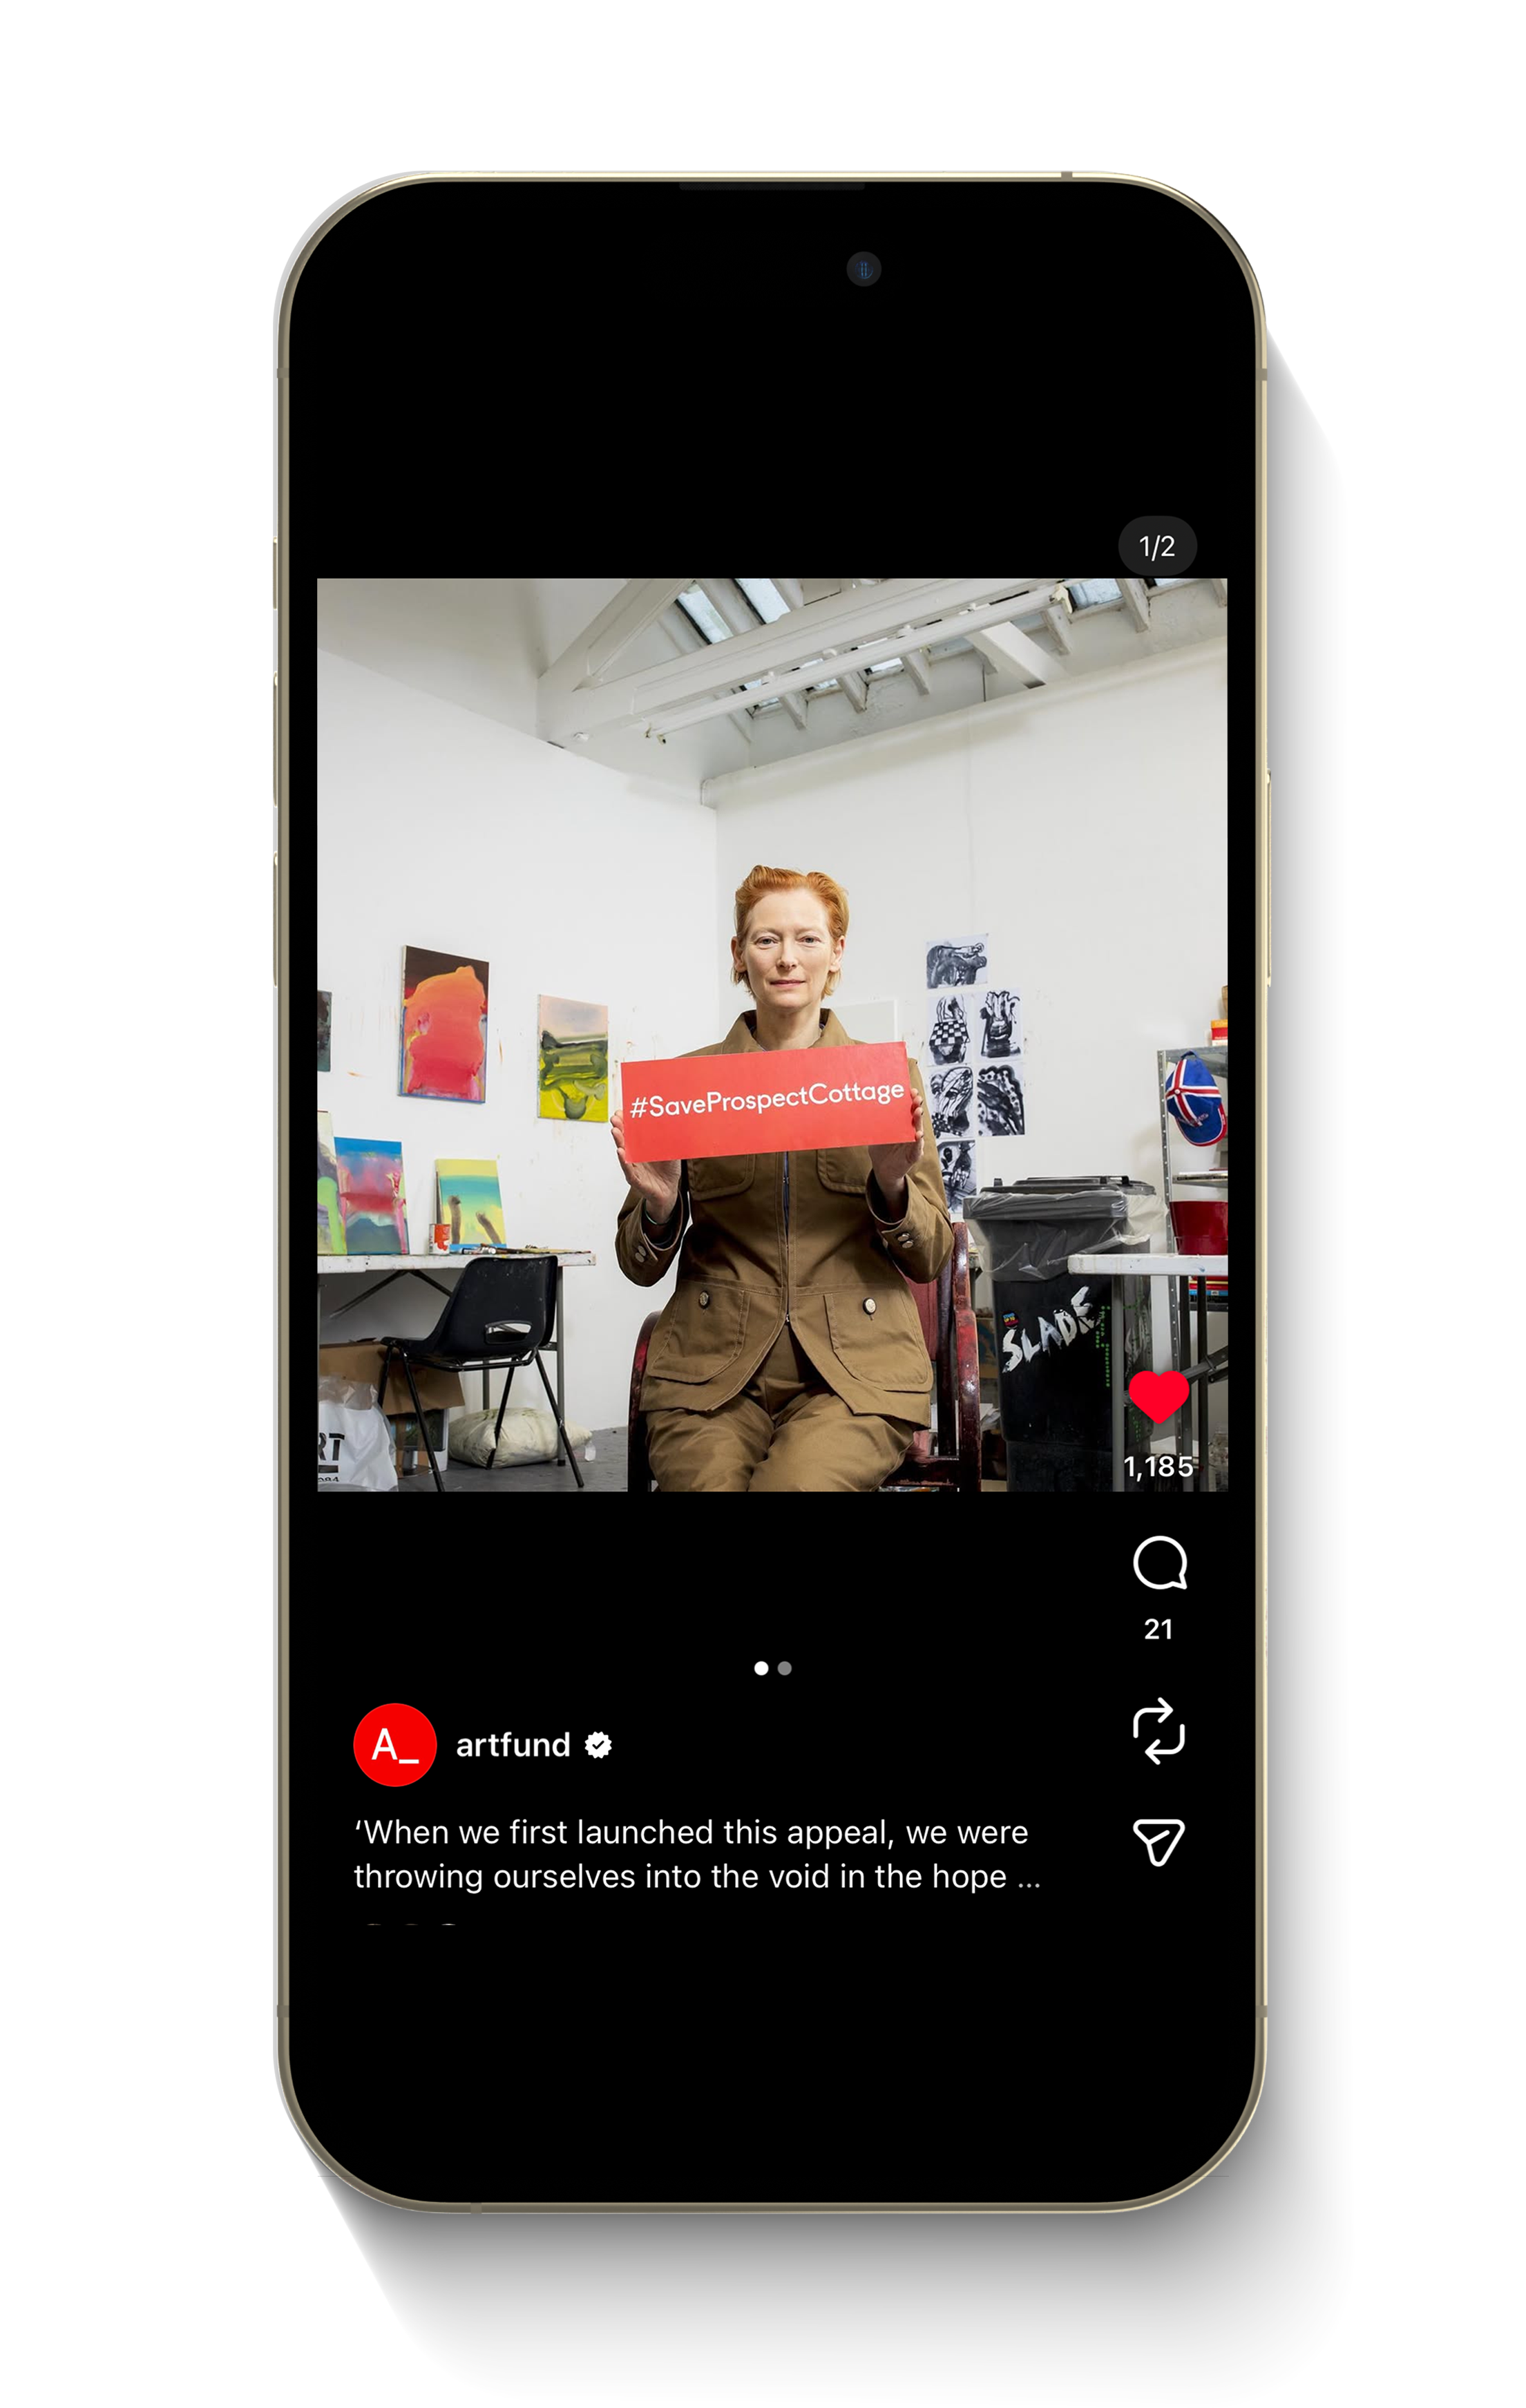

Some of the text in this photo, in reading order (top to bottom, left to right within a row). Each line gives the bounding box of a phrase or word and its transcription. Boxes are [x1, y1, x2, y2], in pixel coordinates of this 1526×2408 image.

[1140, 535, 1175, 562] 1/2
[630, 1082, 906, 1118] #SaveProspectCottage
[1002, 1286, 1096, 1373] SLADE
[1124, 1456, 1194, 1482] 1,185
[1144, 1618, 1172, 1640] 21
[457, 1731, 570, 1757] artfund
[459, 1825, 499, 1844] we
[509, 1819, 567, 1844] first
[578, 1819, 712, 1844] launched
[723, 1819, 777, 1844] this
[788, 1819, 894, 1850] appeal,
[906, 1825, 947, 1844] we
[957, 1825, 1029, 1844] were
[354, 1862, 482, 1894] throwing
[494, 1863, 636, 1889] ourselves
[647, 1862, 701, 1889] into
[711, 1863, 759, 1889] the
[769, 1862, 829, 1889] void
[841, 1862, 864, 1889] in
[875, 1863, 922, 1889] the
[933, 1863, 1007, 1894] hope
